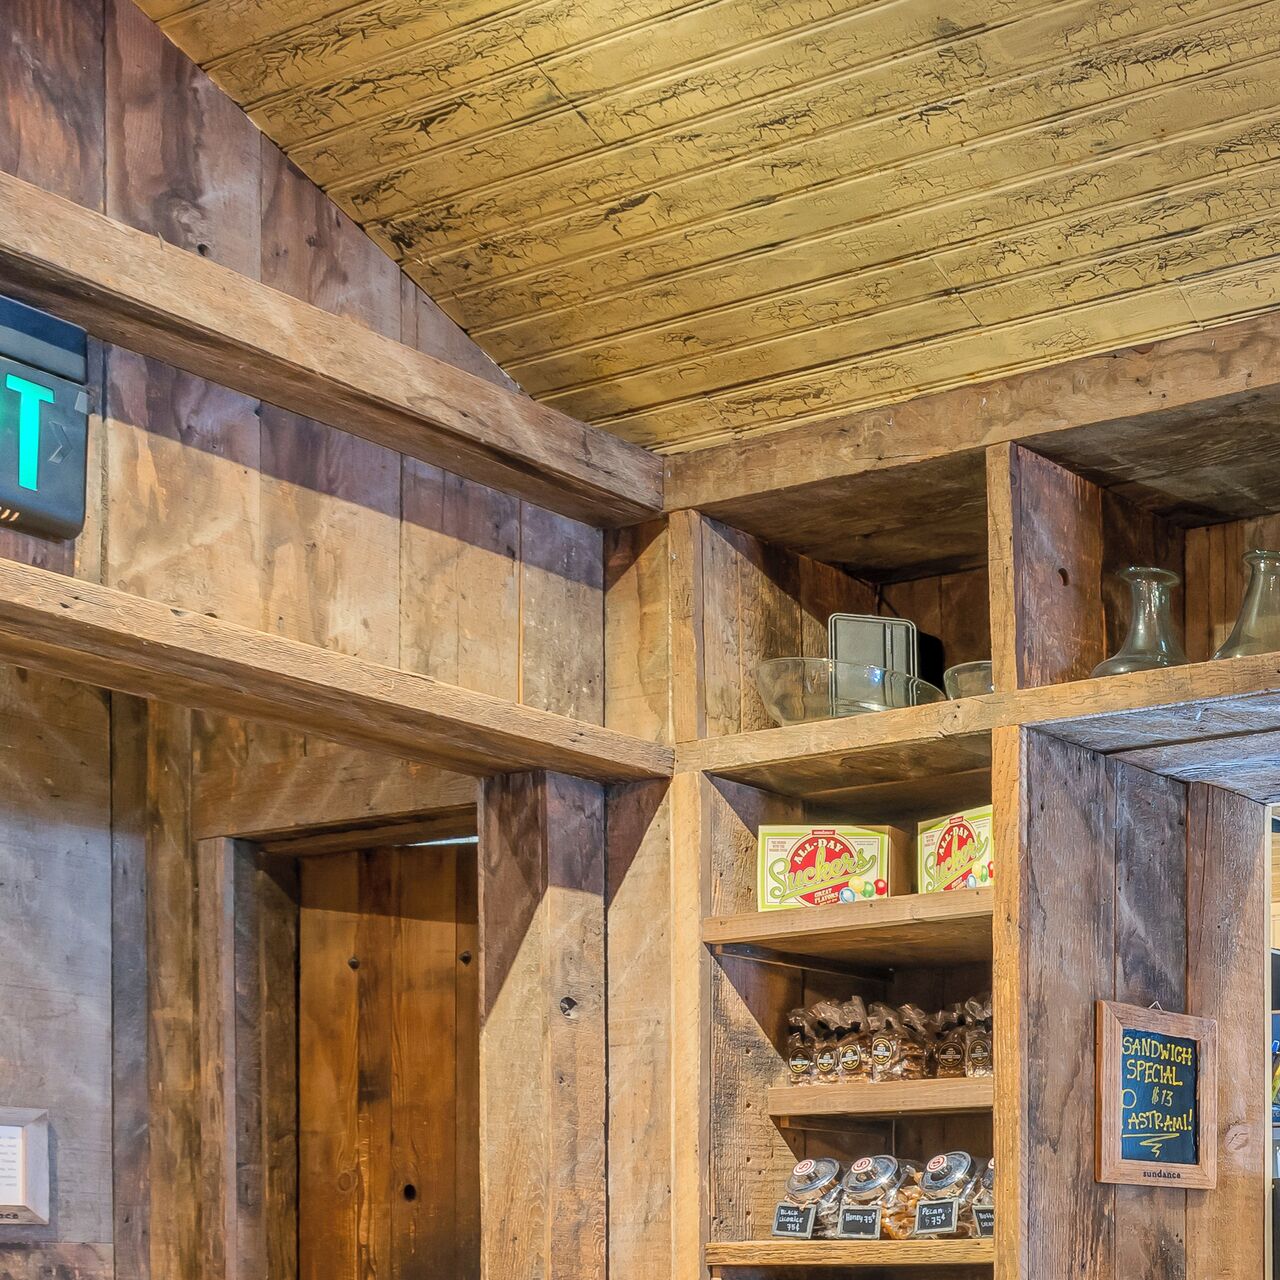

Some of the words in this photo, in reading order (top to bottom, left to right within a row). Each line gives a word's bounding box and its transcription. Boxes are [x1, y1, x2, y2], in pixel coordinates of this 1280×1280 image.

[794, 838, 843, 864] ALL-DAY
[769, 848, 876, 904] Suckers
[1122, 1037, 1192, 1066] SANDWICH
[1127, 1060, 1183, 1086] SPECIAL
[1143, 1169, 1181, 1179] sundance
